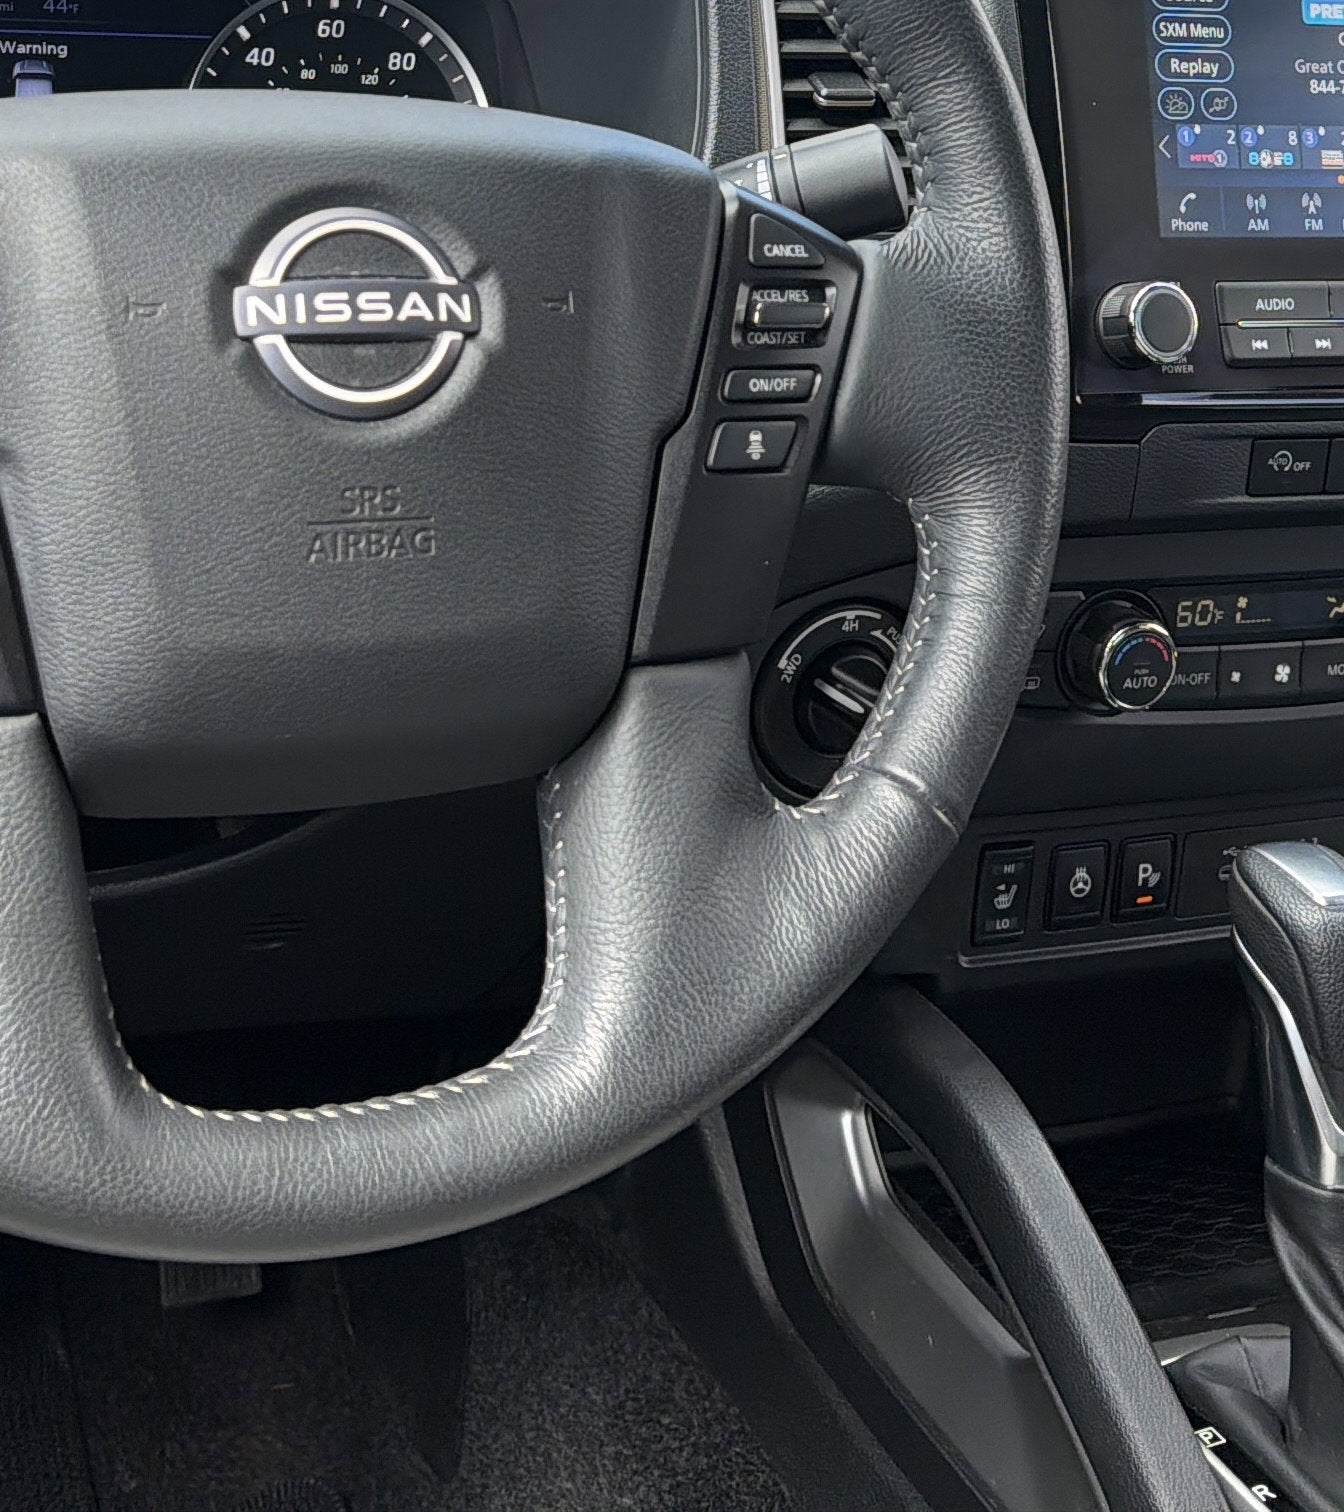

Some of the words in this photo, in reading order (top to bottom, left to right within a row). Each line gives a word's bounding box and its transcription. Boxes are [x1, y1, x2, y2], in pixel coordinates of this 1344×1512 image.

[316, 19, 346, 40] 60
[1159, 21, 1187, 37] SXM
[1189, 23, 1225, 39] Menu
[0, 39, 69, 59] Warning
[245, 47, 276, 68] 40
[388, 51, 417, 72] 80
[299, 67, 317, 81] 80
[329, 63, 349, 76] 100
[1170, 57, 1220, 78] Replay
[1294, 59, 1335, 74] Great
[360, 73, 380, 86] 120
[1226, 129, 1237, 146] 2
[1244, 131, 1254, 144] 2
[1288, 130, 1299, 146] 8
[1171, 218, 1210, 232] Phone
[1247, 218, 1270, 232] AM
[1304, 218, 1324, 232] FM
[763, 244, 809, 258] CANCEL
[752, 289, 810, 304] ACCEL/RES
[245, 291, 473, 327] NISSAN
[1255, 297, 1296, 312] AUDIO
[747, 331, 807, 345] COAST/SET
[1161, 364, 1195, 375] POWER
[748, 377, 798, 393] ON/OFF
[1293, 460, 1312, 472] OFF
[340, 486, 403, 516] SRS
[308, 527, 436, 565] AIRBAG
[841, 620, 860, 633] 4H
[780, 653, 803, 684] 2WD
[1122, 675, 1159, 690] AUTO
[1002, 863, 1016, 875] HI
[1138, 863, 1152, 886] P
[995, 918, 1010, 931] LO
[1251, 1484, 1277, 1501] R
